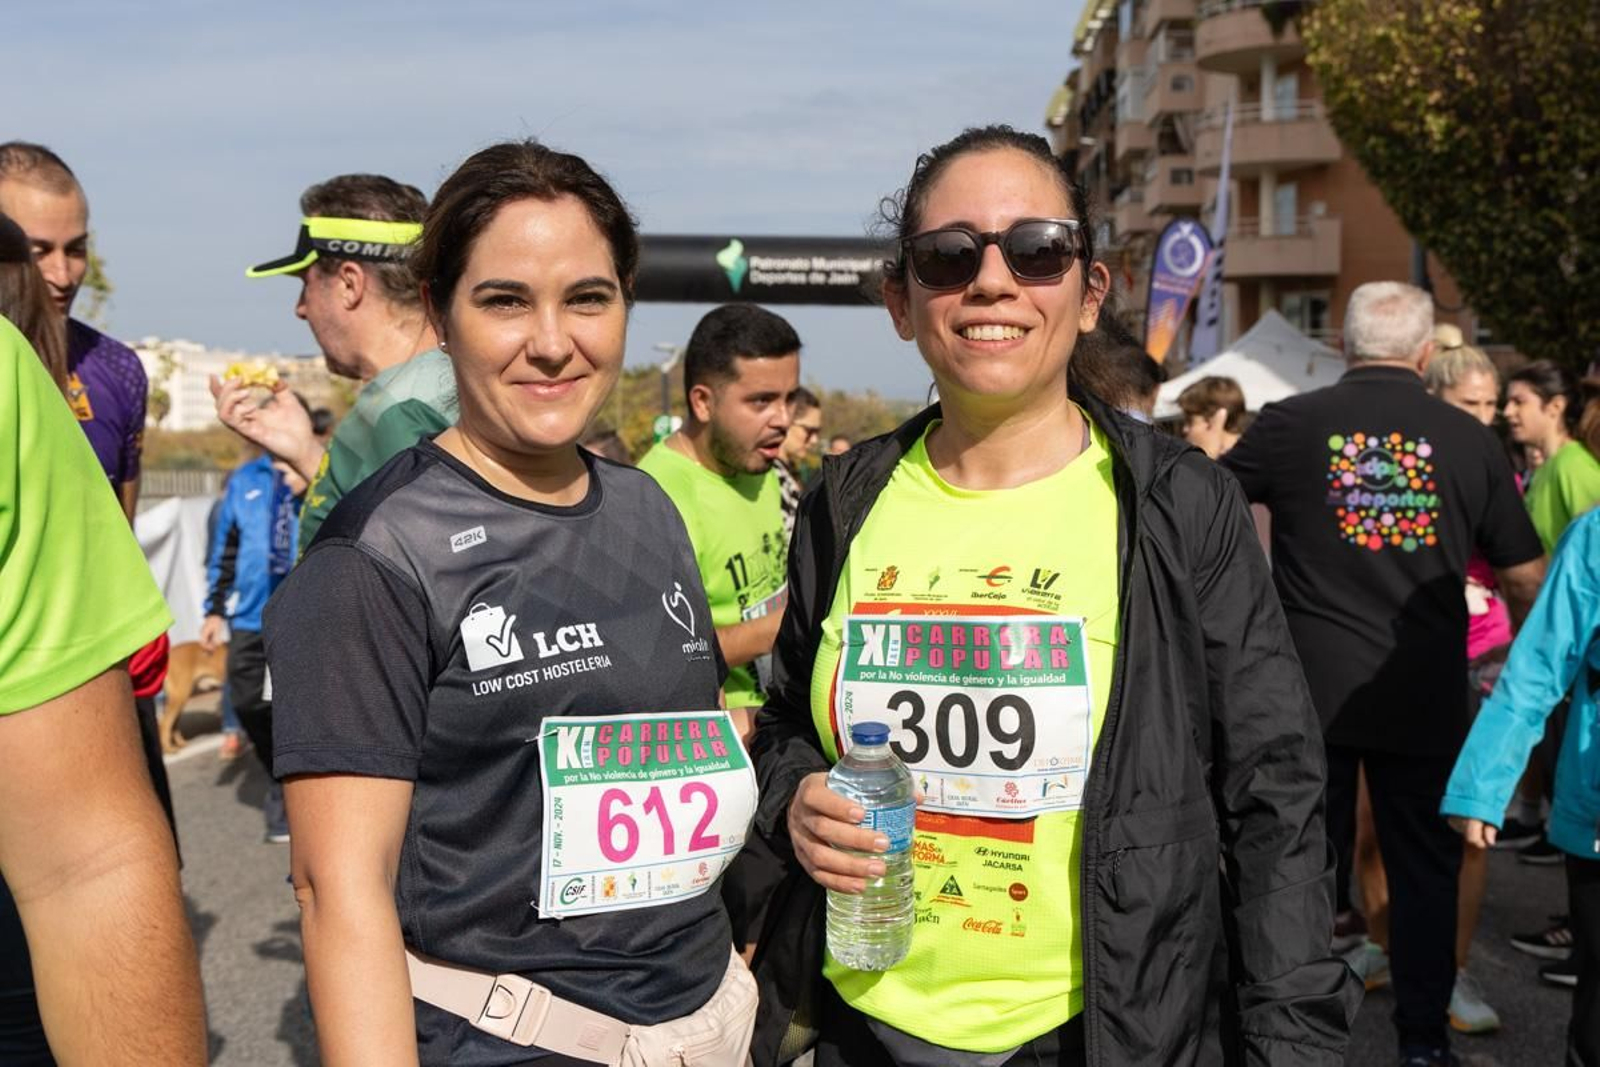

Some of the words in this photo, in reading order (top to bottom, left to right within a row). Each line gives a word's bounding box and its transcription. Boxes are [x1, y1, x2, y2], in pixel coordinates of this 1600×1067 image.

[751, 256, 810, 271] Patronato
[811, 256, 872, 272] Municipal
[751, 270, 806, 285] Deportes
[808, 271, 826, 284] de
[454, 529, 484, 549] 42K
[532, 622, 604, 658] LCH
[857, 623, 902, 667] XI
[905, 623, 1068, 646] CARRERA
[904, 647, 1070, 670] POPULAR
[472, 676, 503, 697] LOW
[505, 668, 540, 690] COST
[542, 655, 613, 681] HOSTELERIA
[860, 670, 875, 680] por
[878, 670, 887, 680] la
[889, 671, 902, 681] No
[905, 672, 947, 683] violencia
[949, 673, 961, 684] de
[962, 673, 994, 686] género
[997, 675, 1005, 686] y
[1007, 674, 1017, 685] la
[1019, 673, 1066, 686] igualdad
[597, 720, 722, 745] CARRERA
[886, 689, 1036, 771] 309
[596, 739, 729, 768] POPULAR
[564, 774, 579, 784] por
[580, 772, 589, 782] la
[589, 772, 602, 782] No
[602, 770, 637, 781] violencia
[637, 769, 648, 780] de
[649, 767, 678, 781] género
[678, 766, 685, 777] y
[685, 764, 694, 775] la
[695, 761, 731, 776] igualdad
[597, 781, 720, 863] 612
[982, 859, 1024, 872] JACARSA
